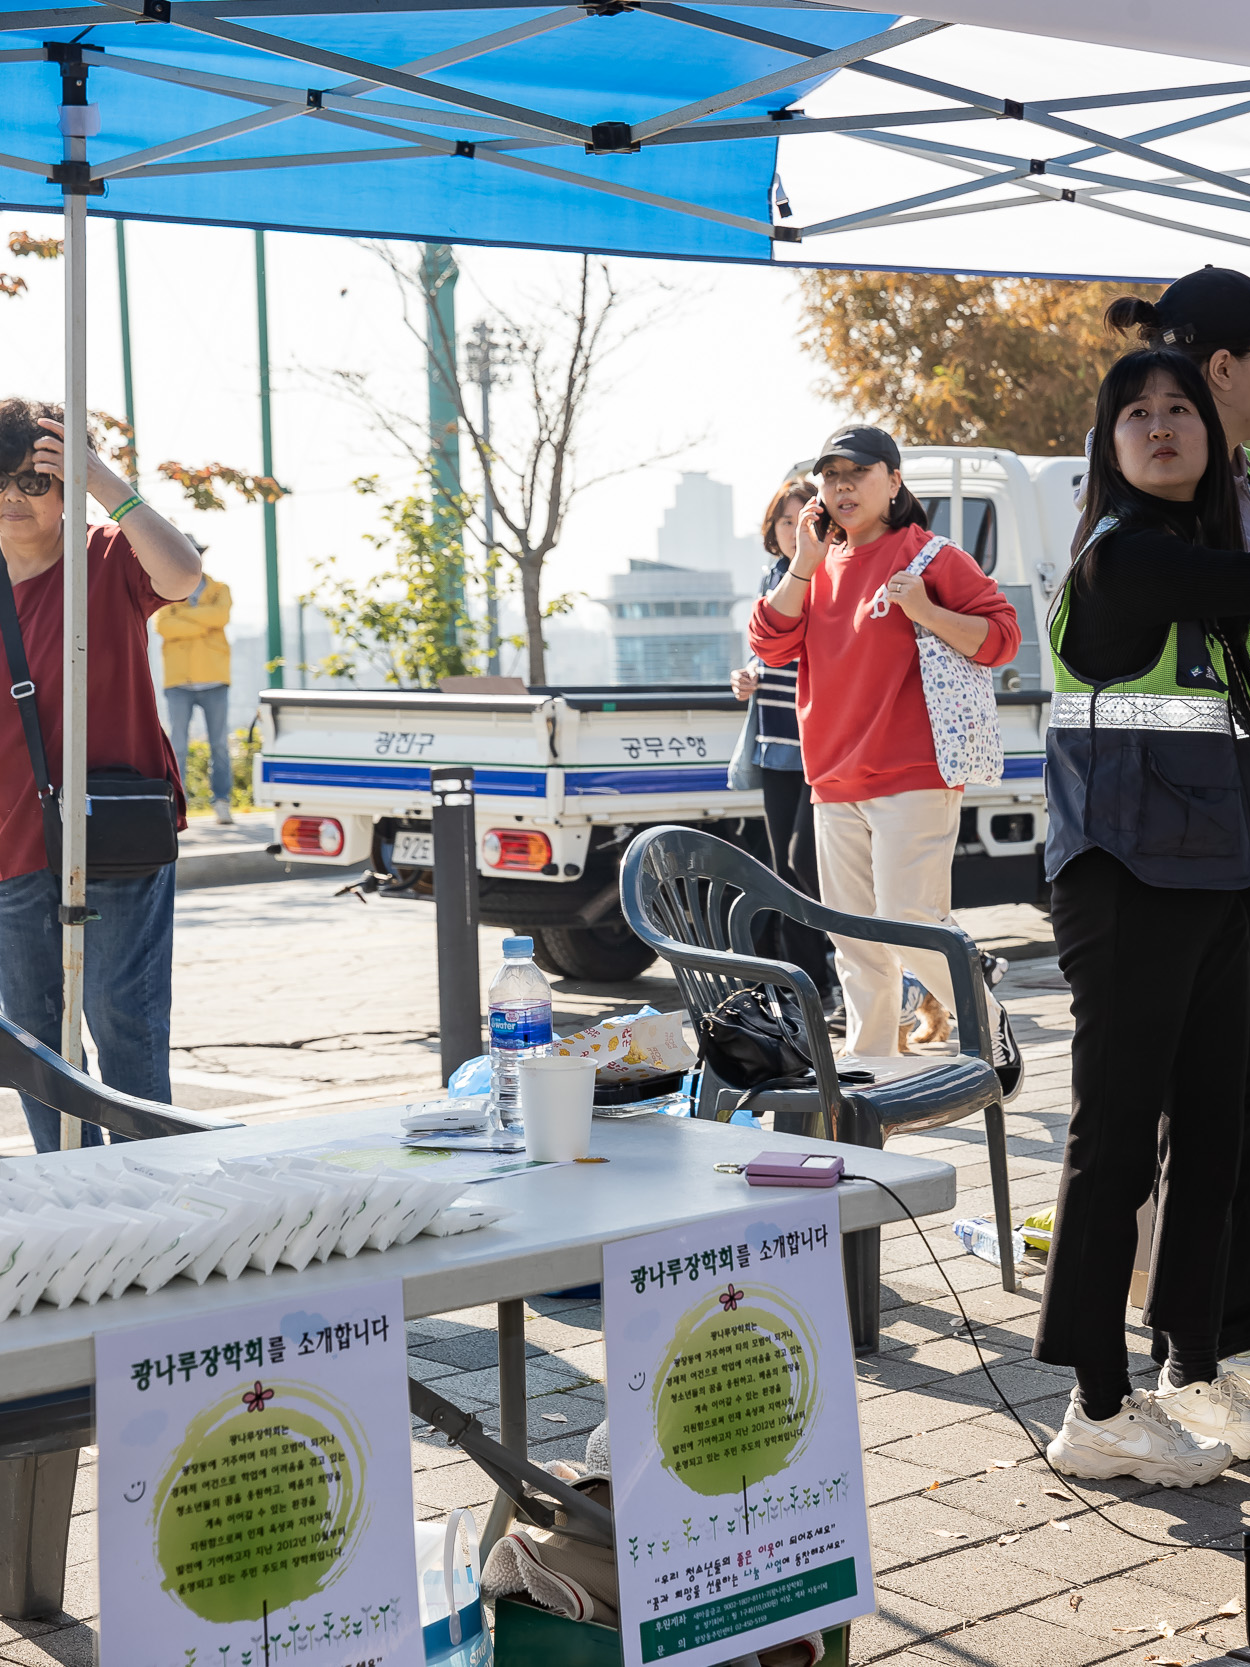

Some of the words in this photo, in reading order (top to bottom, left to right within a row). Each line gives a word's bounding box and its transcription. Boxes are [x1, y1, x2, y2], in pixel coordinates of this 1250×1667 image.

[374, 731, 435, 755] 광진구
[620, 736, 707, 759] 공무수행
[631, 1244, 750, 1294] 광나루장학회를
[760, 1224, 828, 1261] 소개합니다
[674, 1353, 701, 1368] 광장동에
[705, 1345, 732, 1359] 거주하며
[735, 1341, 749, 1352] 타의
[752, 1335, 771, 1348] 모범이
[775, 1329, 793, 1341] 되거나
[711, 1322, 757, 1341] 광나루장학회는
[131, 1336, 286, 1391] 광나루장학회를
[298, 1315, 389, 1355] 소개합니다
[666, 1374, 686, 1387] 경제적
[690, 1366, 718, 1380] 여건으로
[721, 1360, 741, 1372] 학업에
[745, 1352, 771, 1366] 어려움을
[774, 1349, 787, 1359] 겪고
[790, 1345, 802, 1355] 있는
[671, 1386, 705, 1403] 청소년들의
[709, 1382, 722, 1393] 꿈을
[727, 1375, 755, 1389] 응원하고,
[759, 1367, 778, 1379] 배움의
[782, 1361, 800, 1374] 희망을
[695, 1404, 707, 1414] 계속
[712, 1397, 732, 1409] 이어갈
[736, 1395, 742, 1403] 수
[746, 1391, 758, 1401] 있는
[763, 1384, 781, 1396] 환경을
[673, 1441, 693, 1455] 발전에
[698, 1431, 731, 1447] 기여하고자
[736, 1426, 748, 1437] 지난
[752, 1419, 775, 1433] 2012년
[779, 1410, 807, 1426] 10월부터
[683, 1416, 724, 1434] 지원함으로써
[728, 1411, 741, 1423] 인재
[745, 1405, 765, 1417] 육성과
[769, 1395, 795, 1411] 지역사회
[675, 1456, 703, 1471] 운영되고
[707, 1452, 720, 1463] 있는
[724, 1446, 737, 1458] 주민
[741, 1440, 761, 1453] 주도의
[764, 1426, 805, 1447] 장학회입니다.
[675, 1585, 700, 1601] 희망을
[707, 1574, 738, 1594] 선물하는
[744, 1567, 759, 1580] 나눔
[766, 1557, 790, 1573] 사업에
[686, 1556, 730, 1582] 청소년들의
[737, 1550, 752, 1567] 좋은
[758, 1540, 783, 1558] 이웃이
[656, 1614, 687, 1632] 후원계좌
